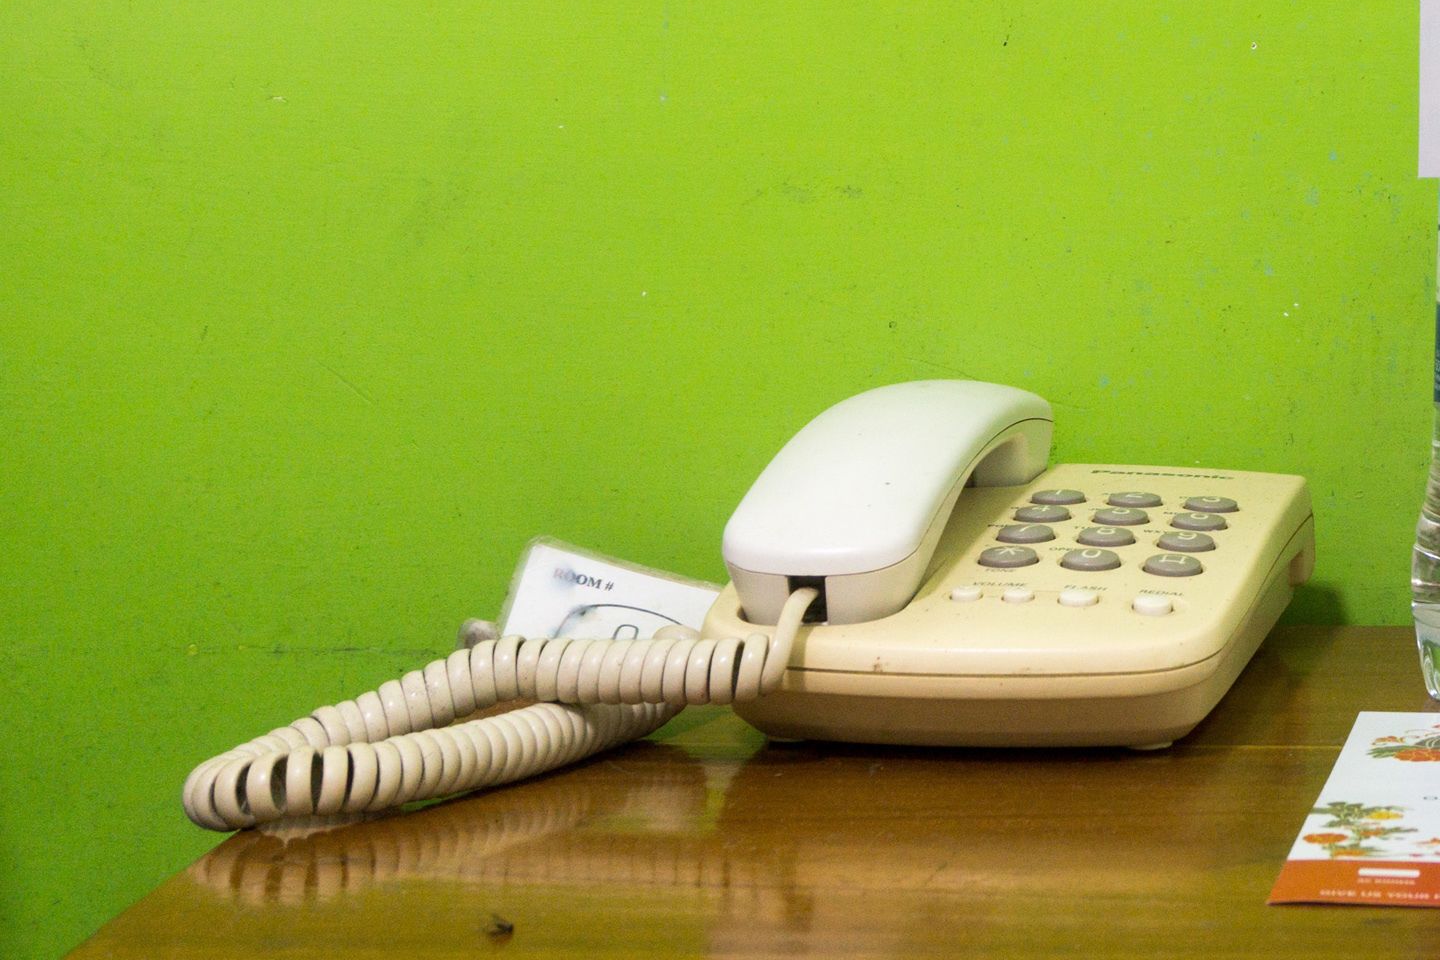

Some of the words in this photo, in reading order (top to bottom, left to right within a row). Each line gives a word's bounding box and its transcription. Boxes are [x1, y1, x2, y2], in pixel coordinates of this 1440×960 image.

[1091, 469, 1235, 480] Panasonic
[553, 566, 603, 590] ROOM
[604, 581, 615, 592] #
[1064, 583, 1108, 591] FLASH
[1138, 588, 1184, 597] REDIAL
